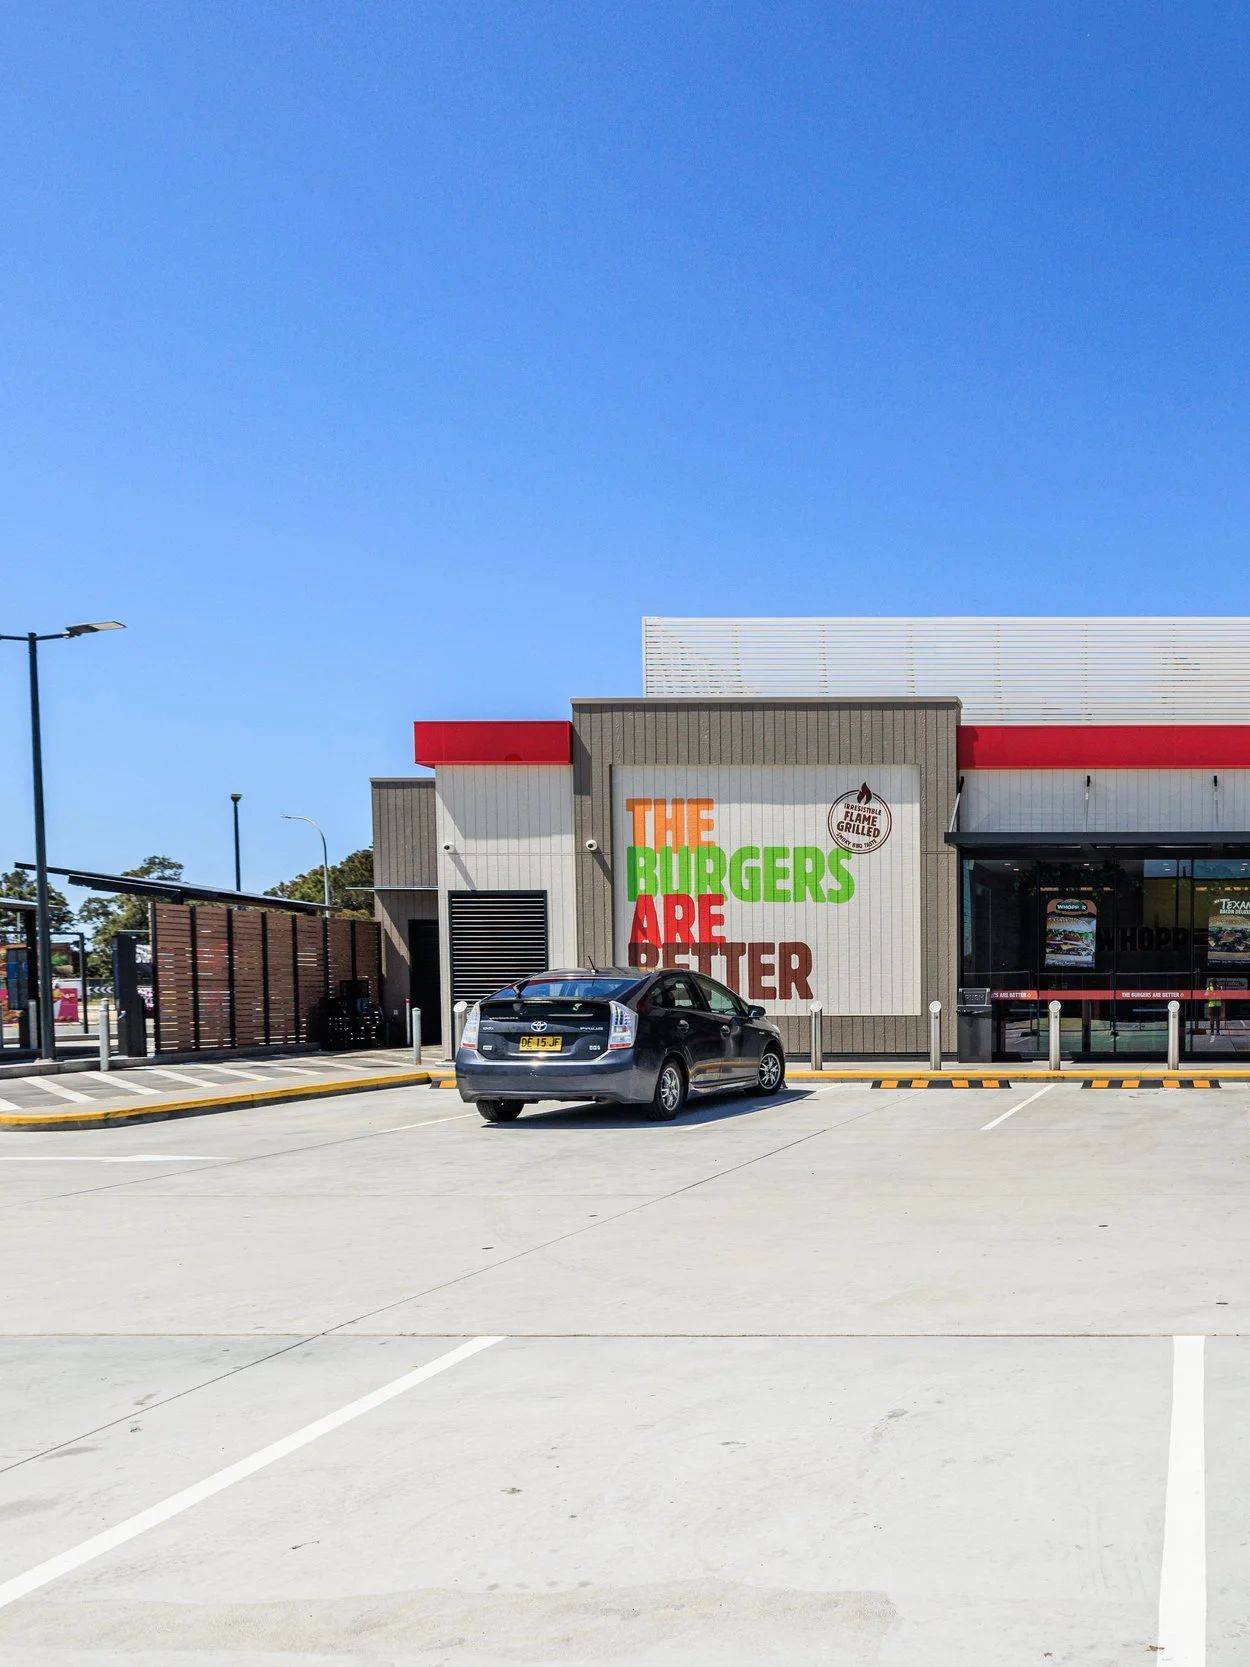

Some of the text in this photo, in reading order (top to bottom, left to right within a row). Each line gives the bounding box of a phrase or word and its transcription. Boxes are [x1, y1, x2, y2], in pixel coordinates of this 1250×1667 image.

[844, 803, 882, 815] IRRESISTIBLE
[626, 798, 716, 854] THE
[844, 811, 878, 827] FLAME
[836, 821, 880, 838] GRILLED
[836, 832, 852, 846] SMOKY
[864, 839, 877, 848] TASTE
[626, 846, 855, 904] BURGERS
[630, 894, 727, 949] ARE
